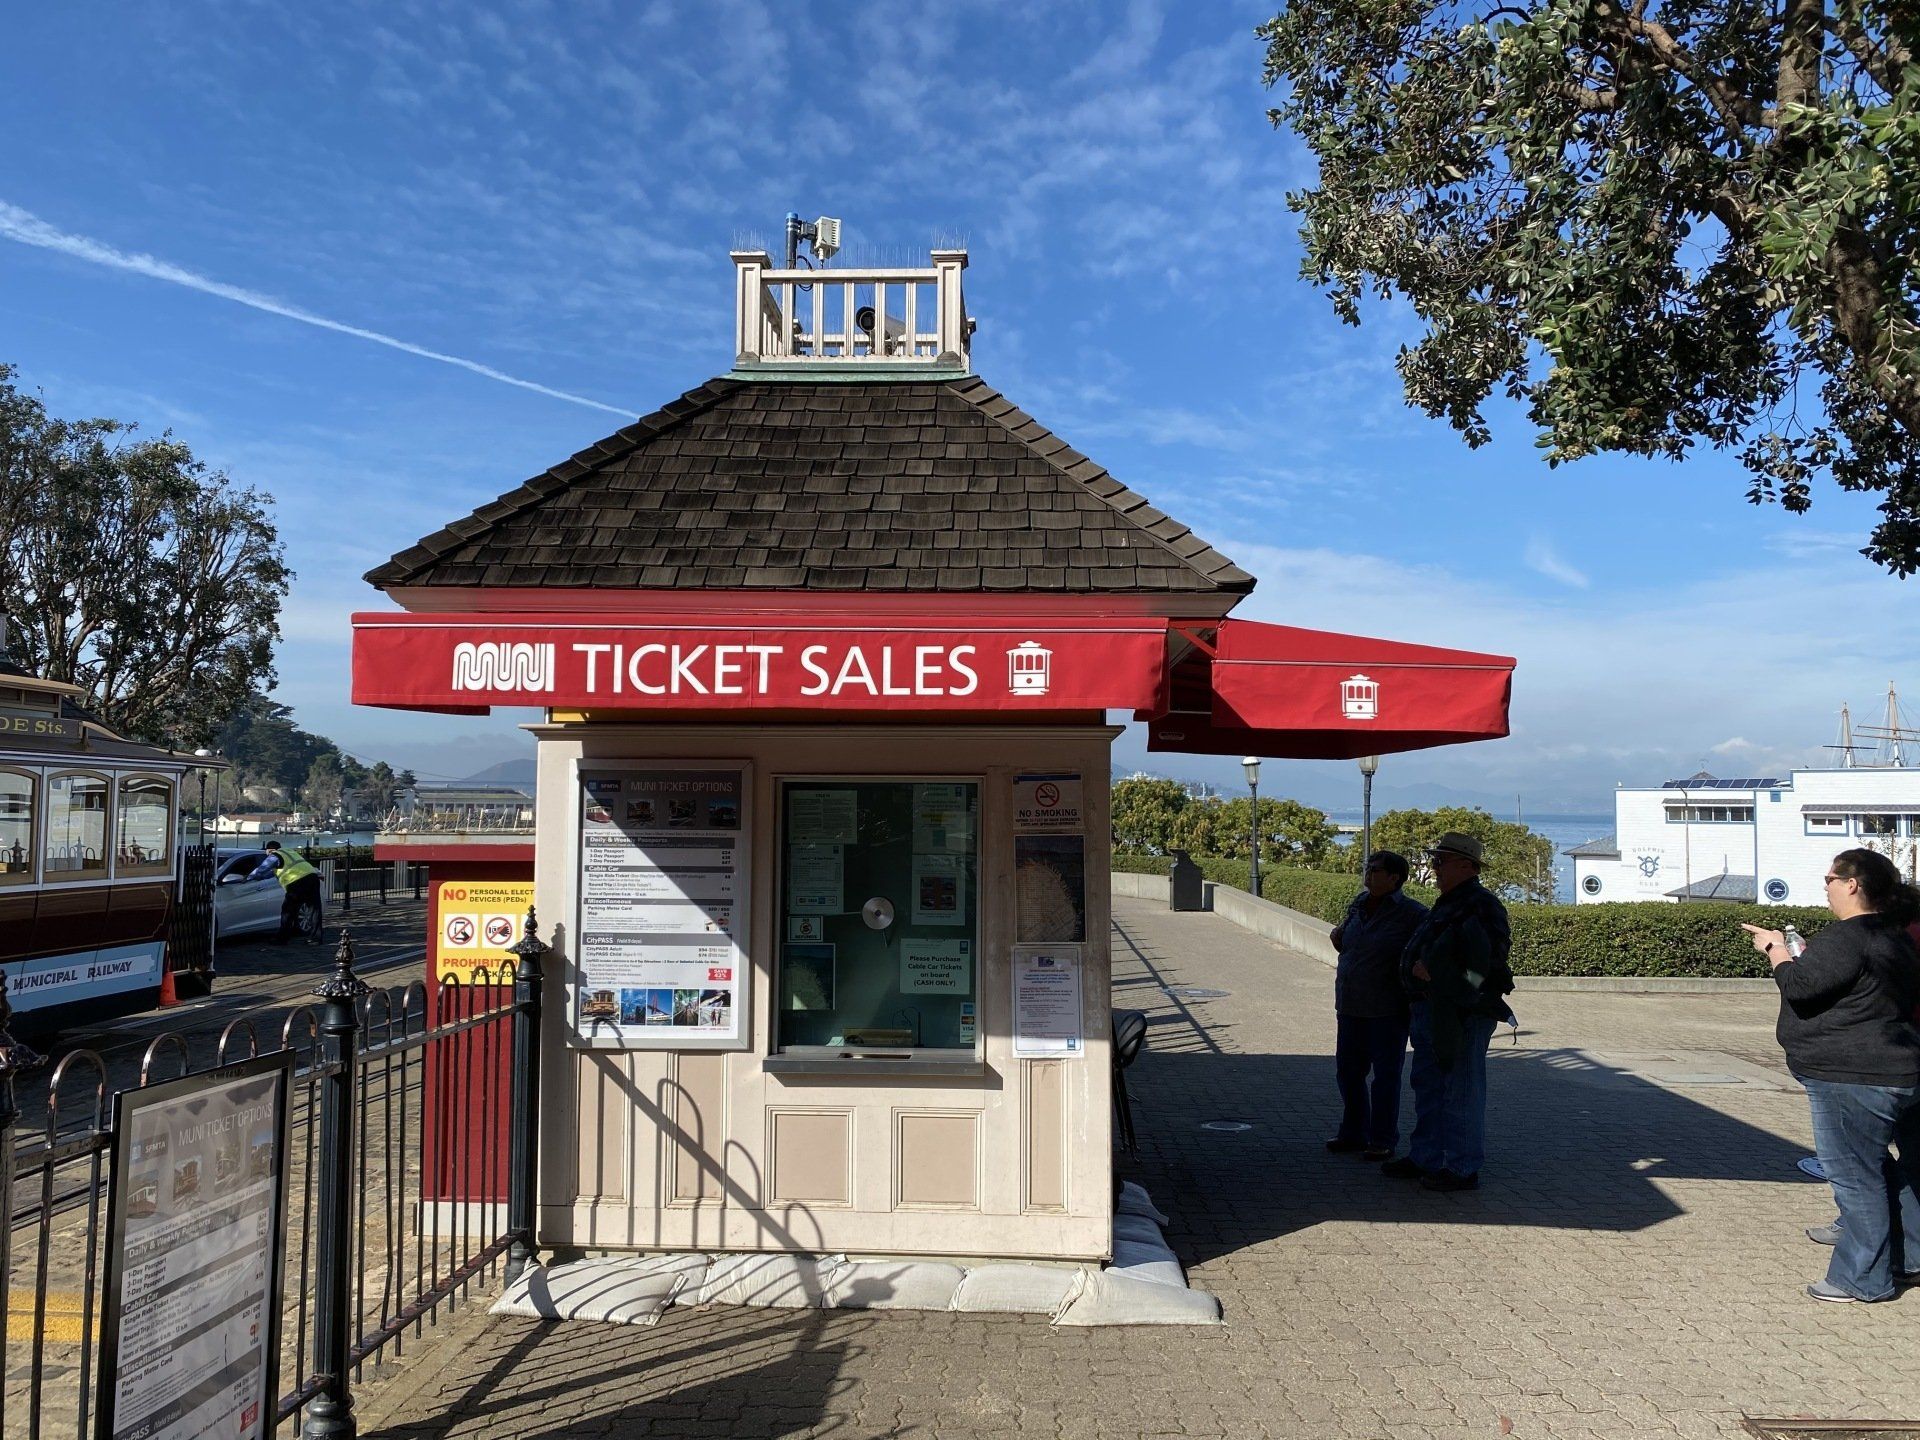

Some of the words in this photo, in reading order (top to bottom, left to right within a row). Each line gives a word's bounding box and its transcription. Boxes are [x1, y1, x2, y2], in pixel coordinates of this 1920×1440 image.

[451, 642, 555, 692] MUNI
[573, 643, 783, 696] TICKET
[800, 645, 978, 697] SALES
[35, 720, 66, 734] Sts.
[631, 782, 656, 791] MUNI
[659, 782, 690, 792] TICKET
[693, 782, 733, 792] OPTIONS
[1019, 809, 1032, 817] NO
[1035, 809, 1077, 817] SMOKING
[444, 889, 466, 900] NO
[13, 969, 78, 990] MUNICIPAL
[87, 961, 133, 978] RAILWAY
[935, 980, 956, 988] ONLY)
[178, 1125, 205, 1147] MUNI
[207, 1113, 237, 1137] TICKET
[238, 1102, 272, 1128] OPTIONS
[145, 1141, 166, 1154] SFMTA
[129, 1244, 148, 1258] Daily
[144, 1257, 167, 1272] Passport
[144, 1266, 166, 1280] Passport
[144, 1275, 165, 1290] Passport
[124, 1313, 140, 1326] Single
[154, 1299, 169, 1310] Ticket
[123, 1330, 140, 1343] Round
[140, 1324, 150, 1334] Trip
[122, 1344, 172, 1376] Miscellaneous
[122, 1372, 142, 1389] Parking
[160, 1354, 173, 1367] Card
[122, 1388, 134, 1398] Map
